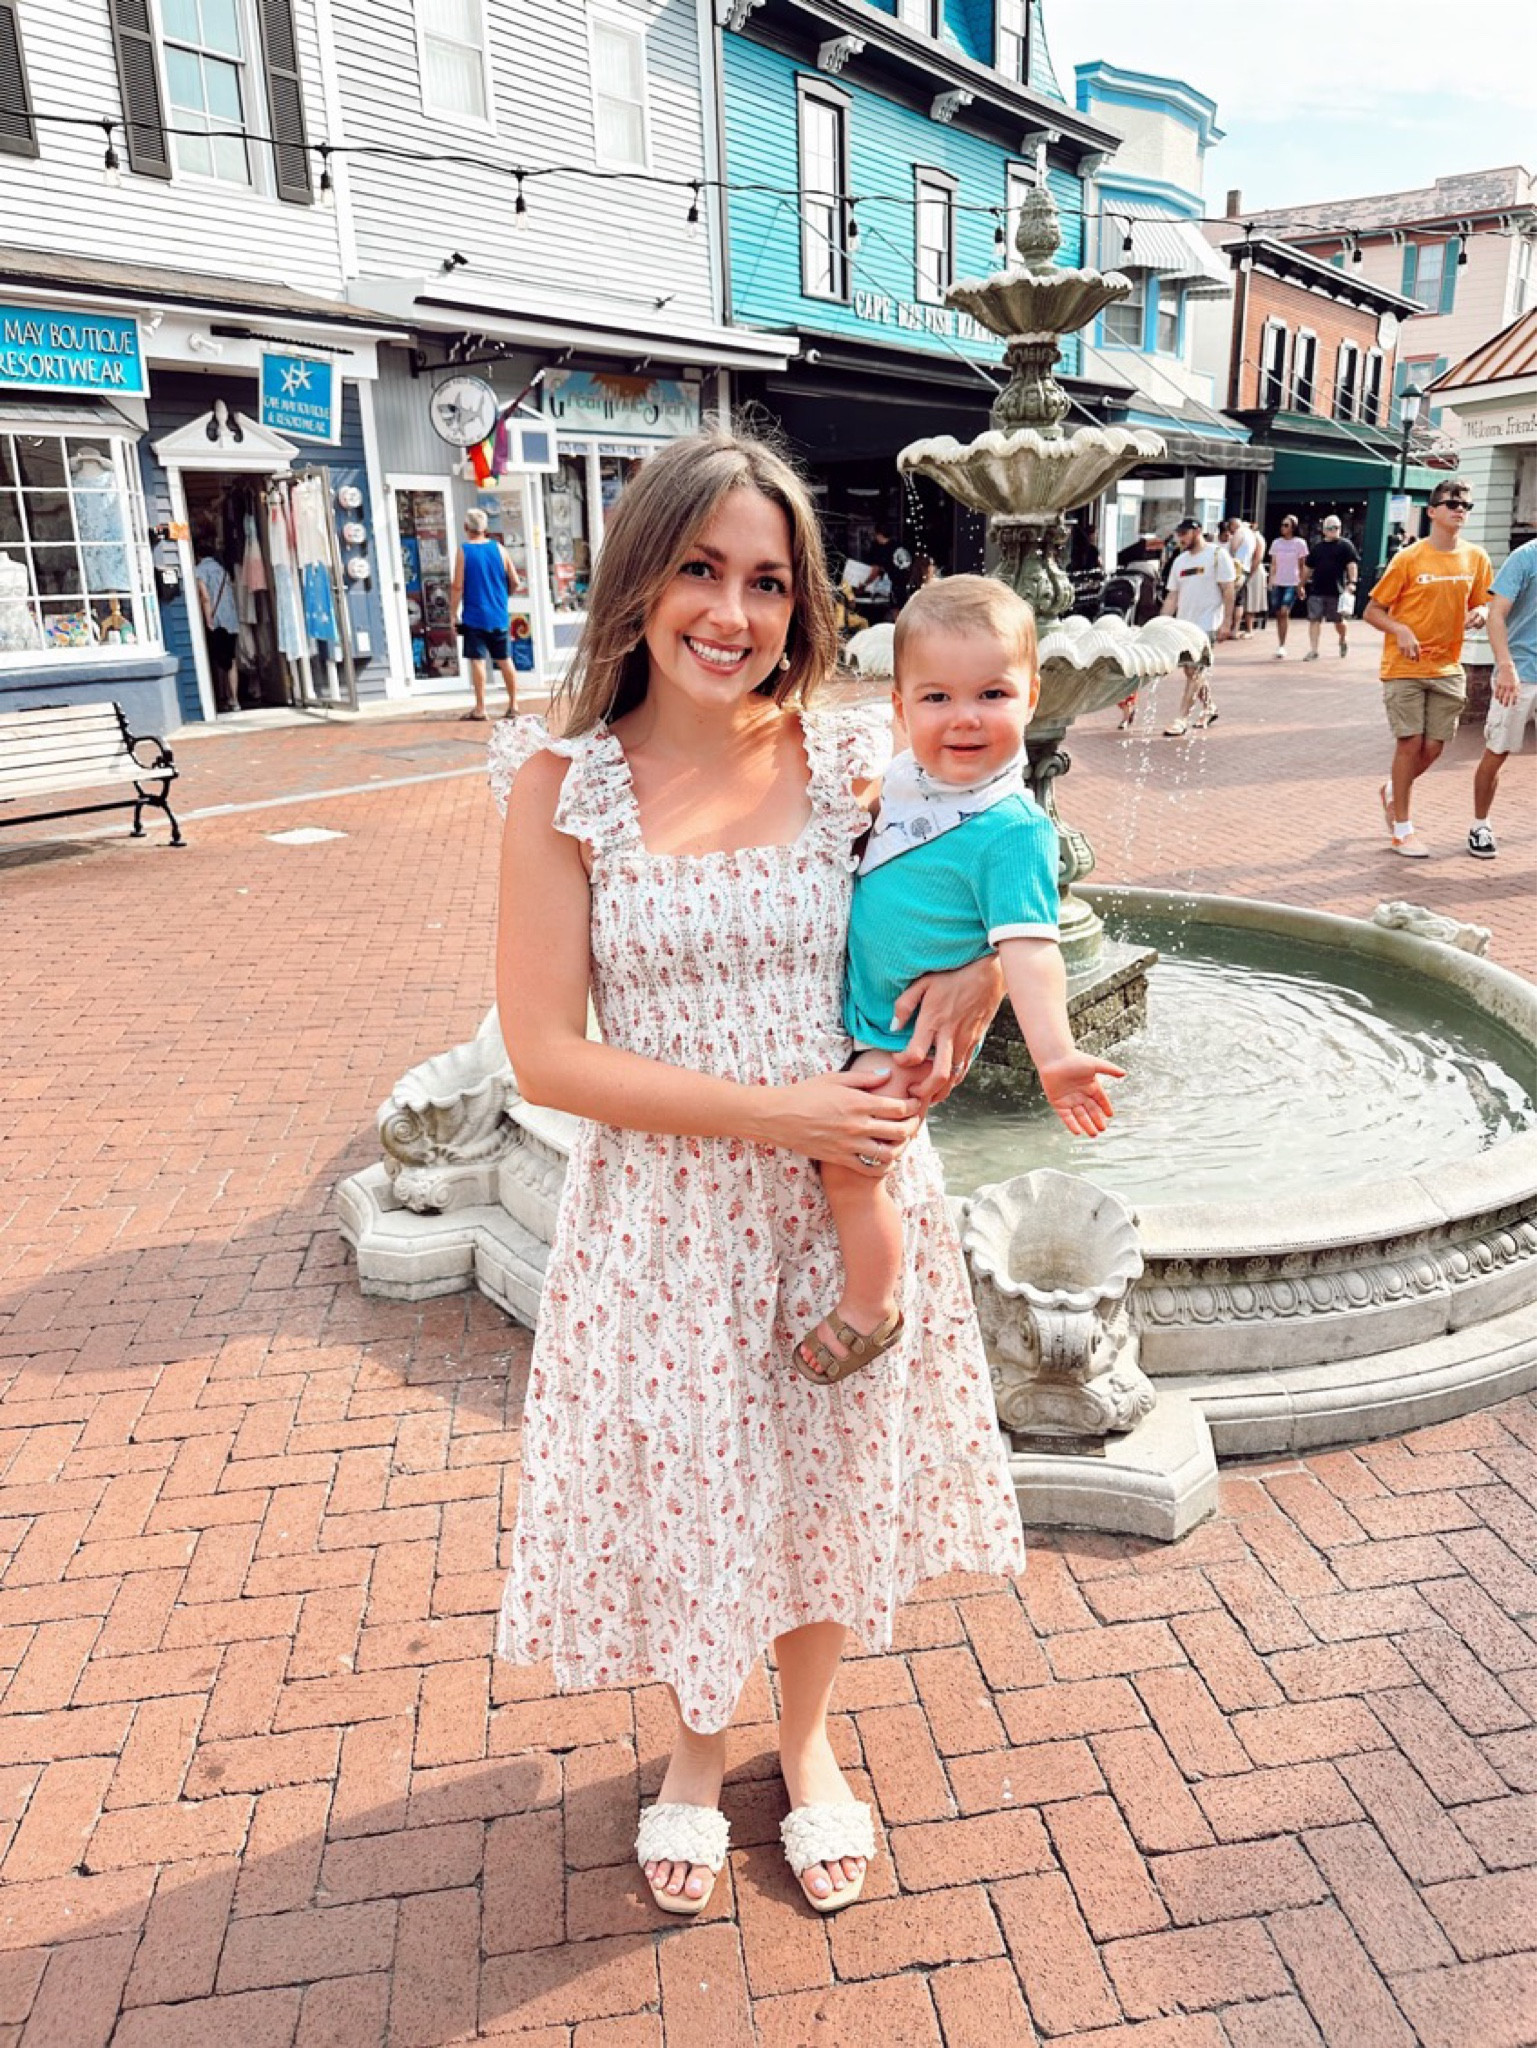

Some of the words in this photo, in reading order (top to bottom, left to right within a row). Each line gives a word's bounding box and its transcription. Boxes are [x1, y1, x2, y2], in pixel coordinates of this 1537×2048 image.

[855, 290, 892, 324] CAPE
[4, 318, 45, 346] MAY
[50, 322, 135, 356] BOUTIQUE
